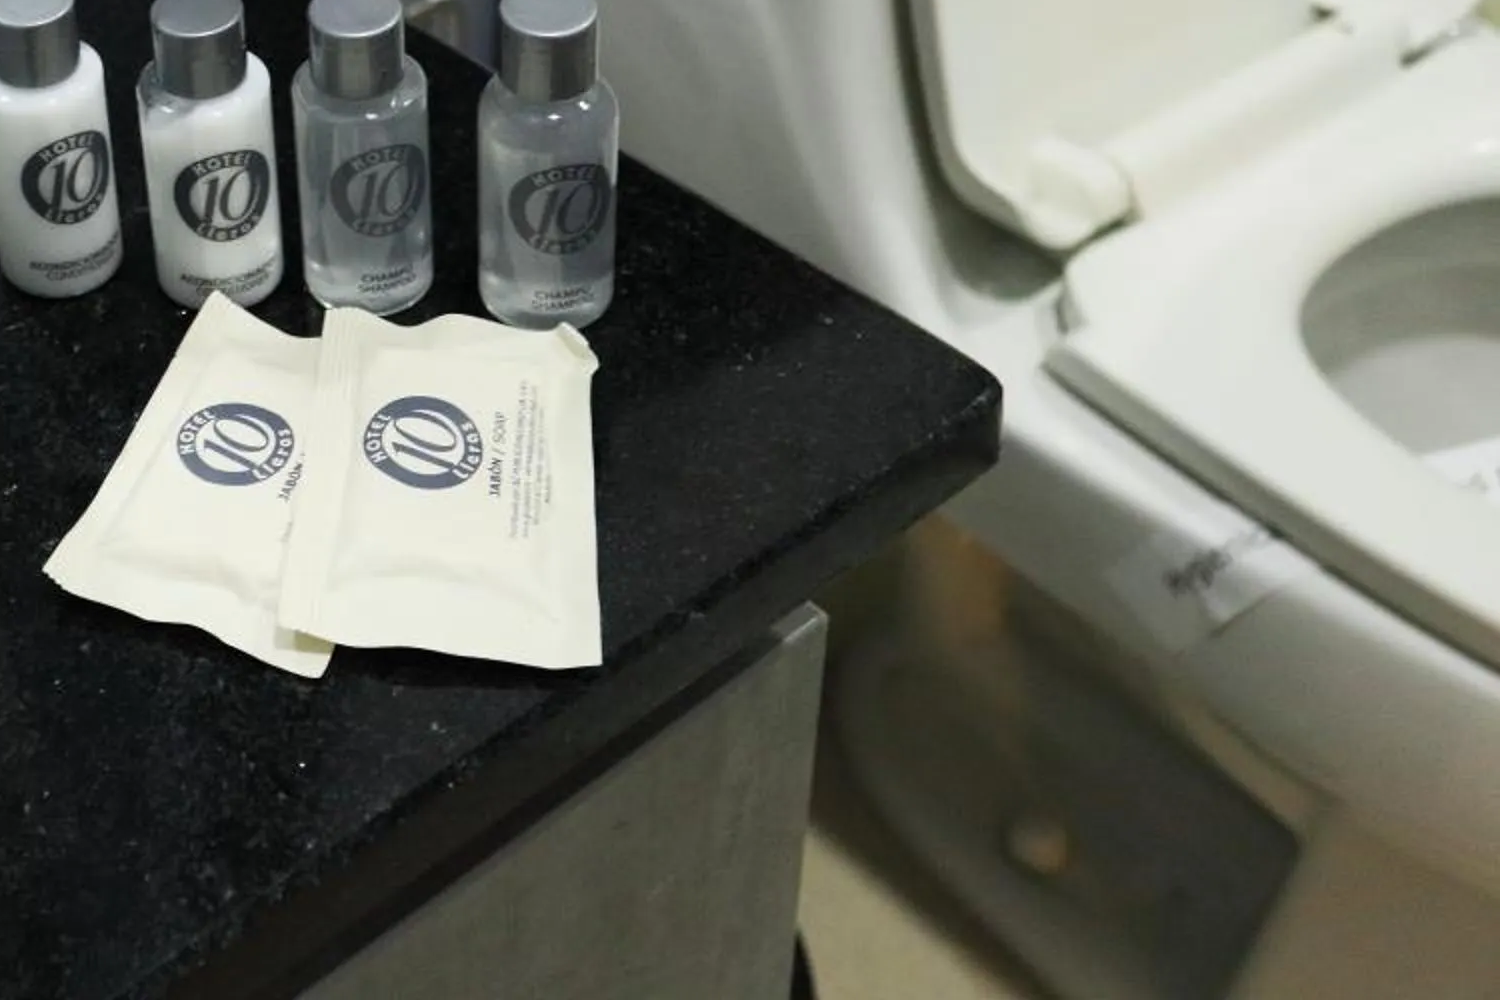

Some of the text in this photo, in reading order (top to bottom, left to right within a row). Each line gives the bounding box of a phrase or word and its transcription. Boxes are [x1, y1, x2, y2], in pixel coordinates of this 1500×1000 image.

[49, 151, 101, 216] 10
[202, 171, 255, 228] 10
[363, 163, 412, 230] 10
[538, 183, 598, 241] 10
[179, 408, 217, 455] HOTEL
[203, 414, 271, 470] 10
[365, 413, 391, 463] HOTEL
[391, 409, 458, 469] 10
